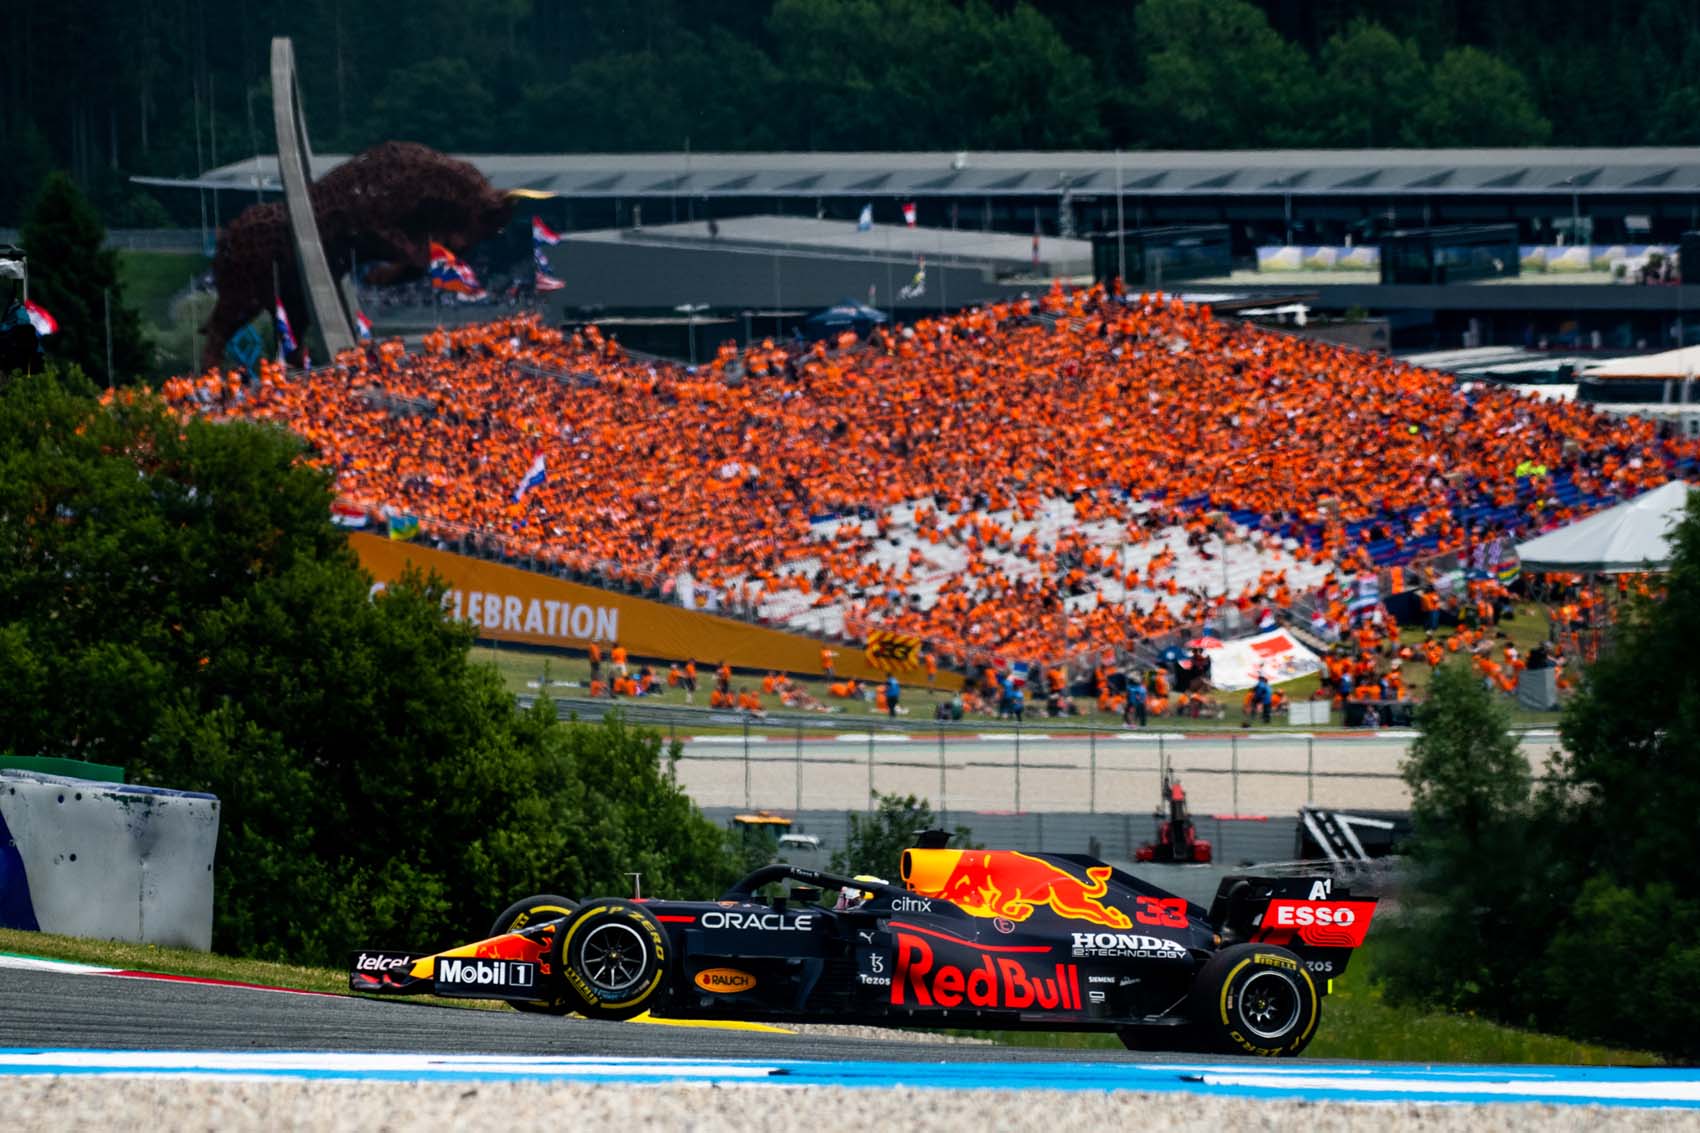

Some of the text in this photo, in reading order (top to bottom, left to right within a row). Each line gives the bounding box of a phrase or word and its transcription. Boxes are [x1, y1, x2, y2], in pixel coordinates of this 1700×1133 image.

[424, 587, 618, 642] ELEBRATION
[891, 896, 932, 913] citrix
[1136, 895, 1189, 928] 33
[701, 911, 813, 931] ORACLE
[1277, 905, 1355, 926] ESSO
[1071, 932, 1187, 951] HONDA
[439, 959, 506, 984] Mobil
[711, 975, 749, 985] RAUCH
[860, 974, 891, 986] Tezos
